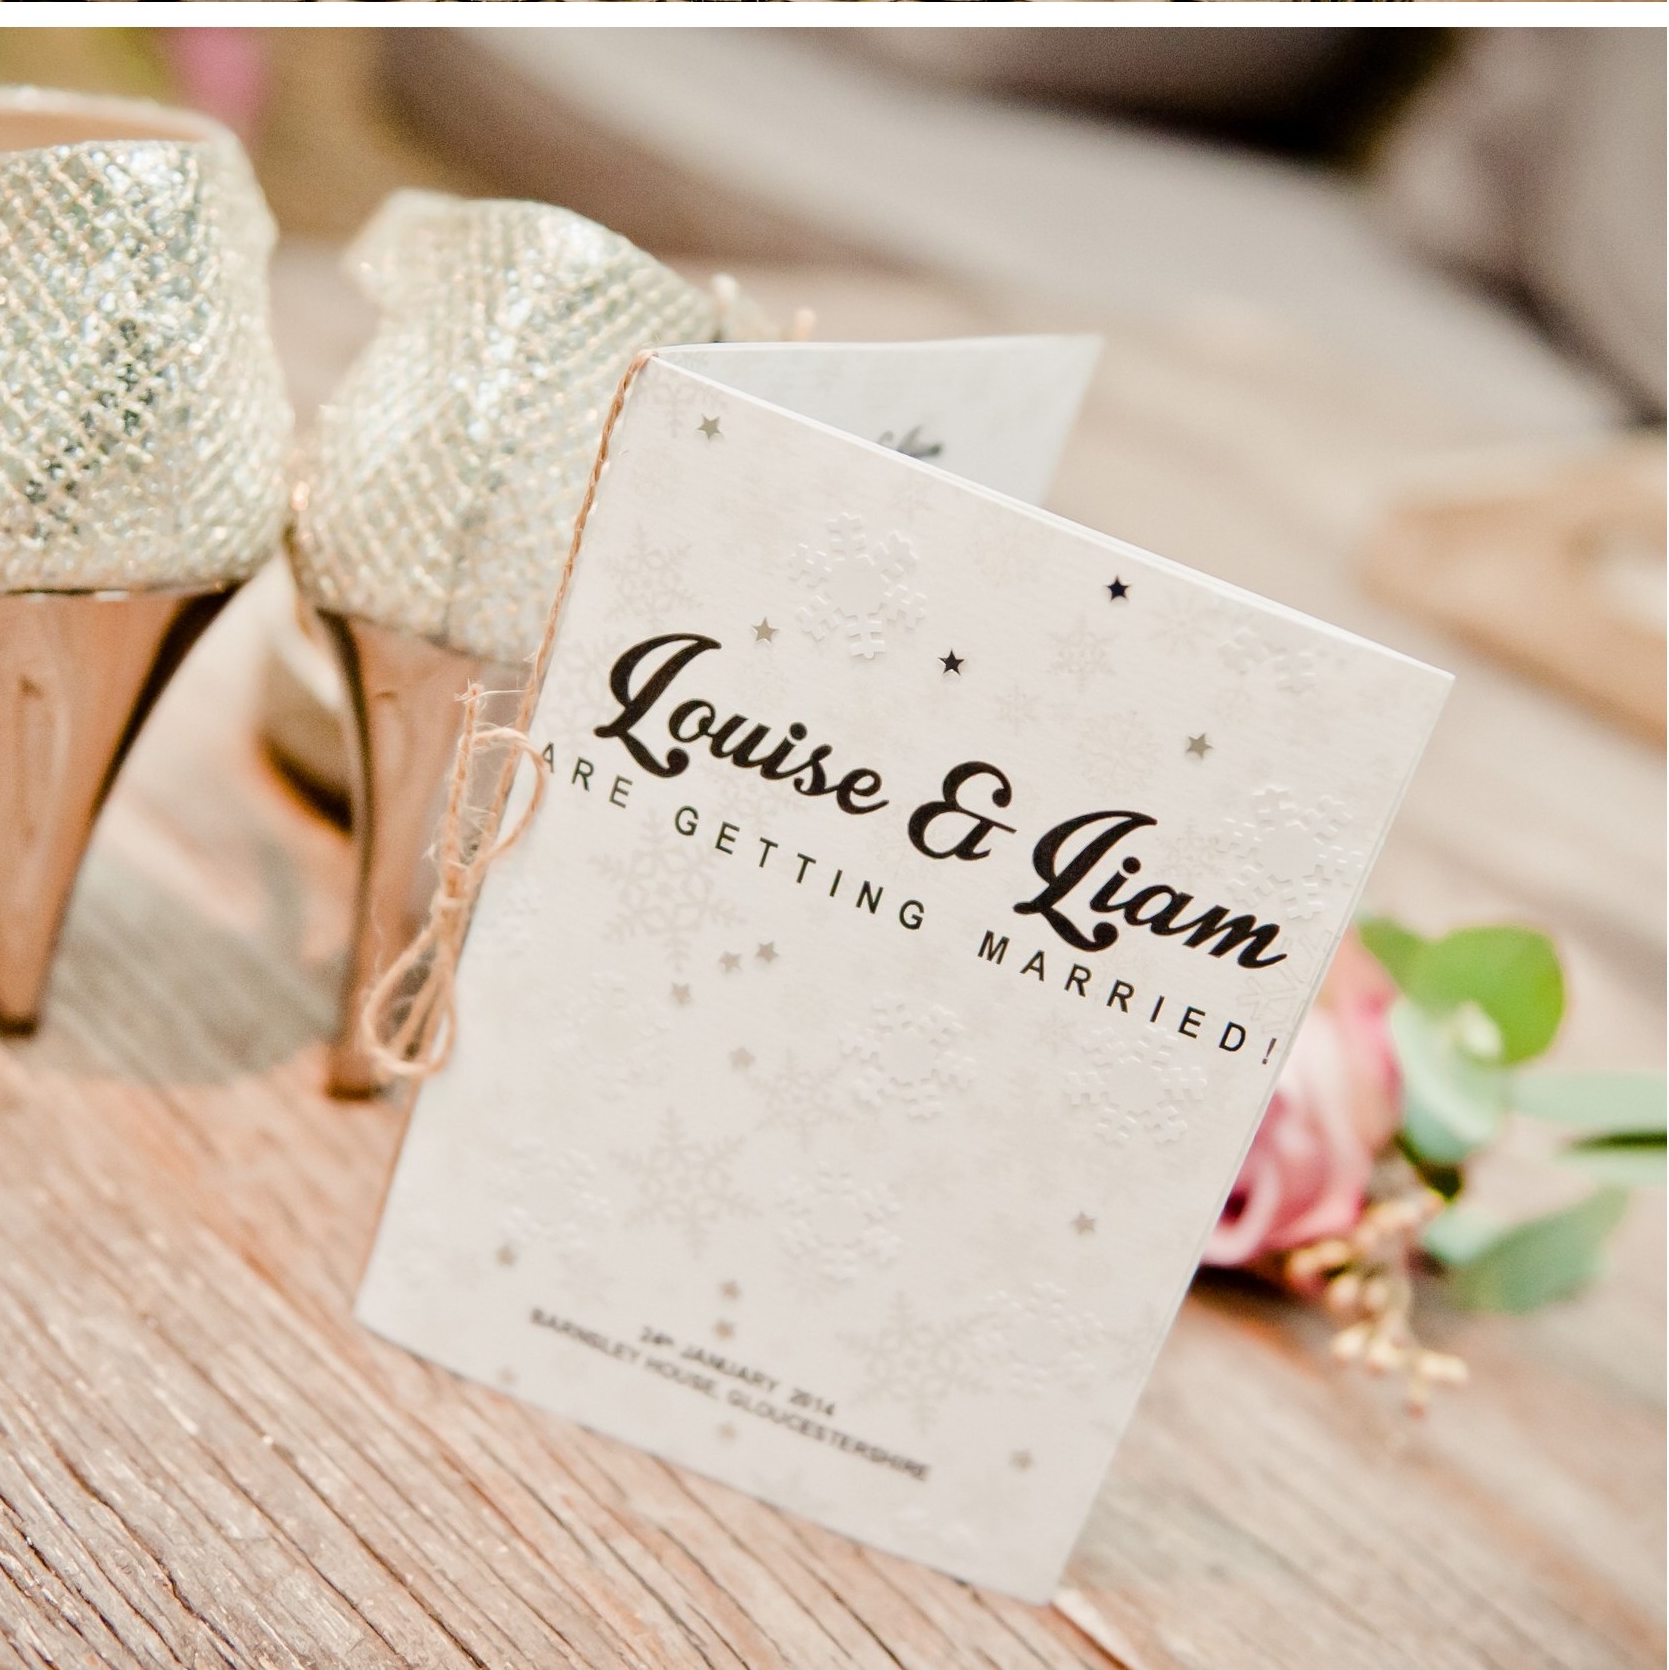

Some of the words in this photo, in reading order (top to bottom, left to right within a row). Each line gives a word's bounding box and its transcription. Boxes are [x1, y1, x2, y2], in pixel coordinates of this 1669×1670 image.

[540, 741, 634, 809] ARE
[673, 805, 925, 931] GETTING
[976, 929, 1277, 1065] MARRIED!
[592, 632, 890, 816] Louise
[906, 758, 1018, 863] &
[1012, 809, 1288, 970] Liam
[530, 1307, 641, 1364] BARNSLEY
[726, 1388, 929, 1482] GLOUCESTERSHIRE
[680, 1344, 779, 1393] JANUARY
[790, 1387, 836, 1417] 2014
